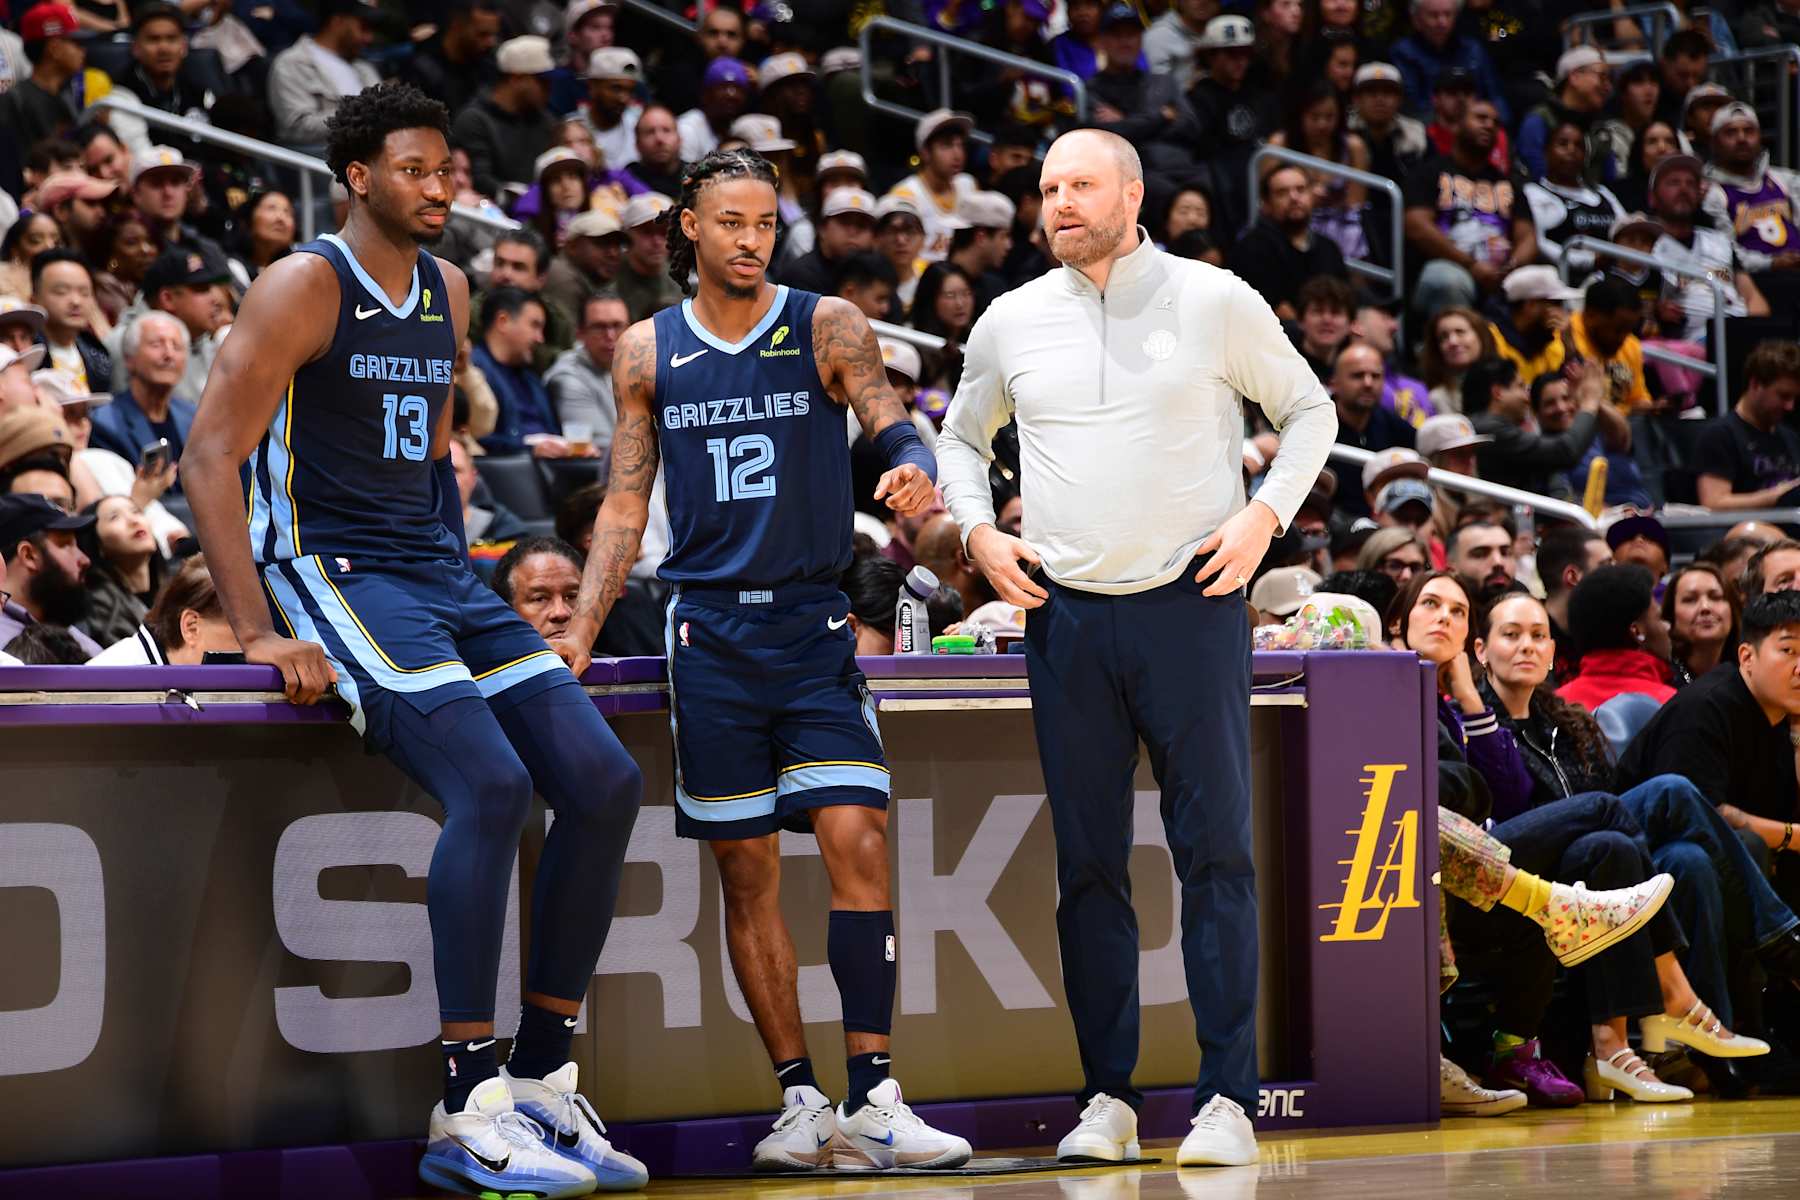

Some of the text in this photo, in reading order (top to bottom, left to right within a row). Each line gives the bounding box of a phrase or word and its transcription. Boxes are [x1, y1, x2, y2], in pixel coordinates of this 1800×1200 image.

[350, 354, 452, 384] GRIZZLIES
[760, 348, 800, 358] Robinhood
[382, 394, 429, 461] 13
[664, 391, 810, 429] GRIZZLIES
[706, 434, 777, 502] 12
[902, 606, 911, 651] COURT GRIP
[1318, 764, 1420, 941] LA
